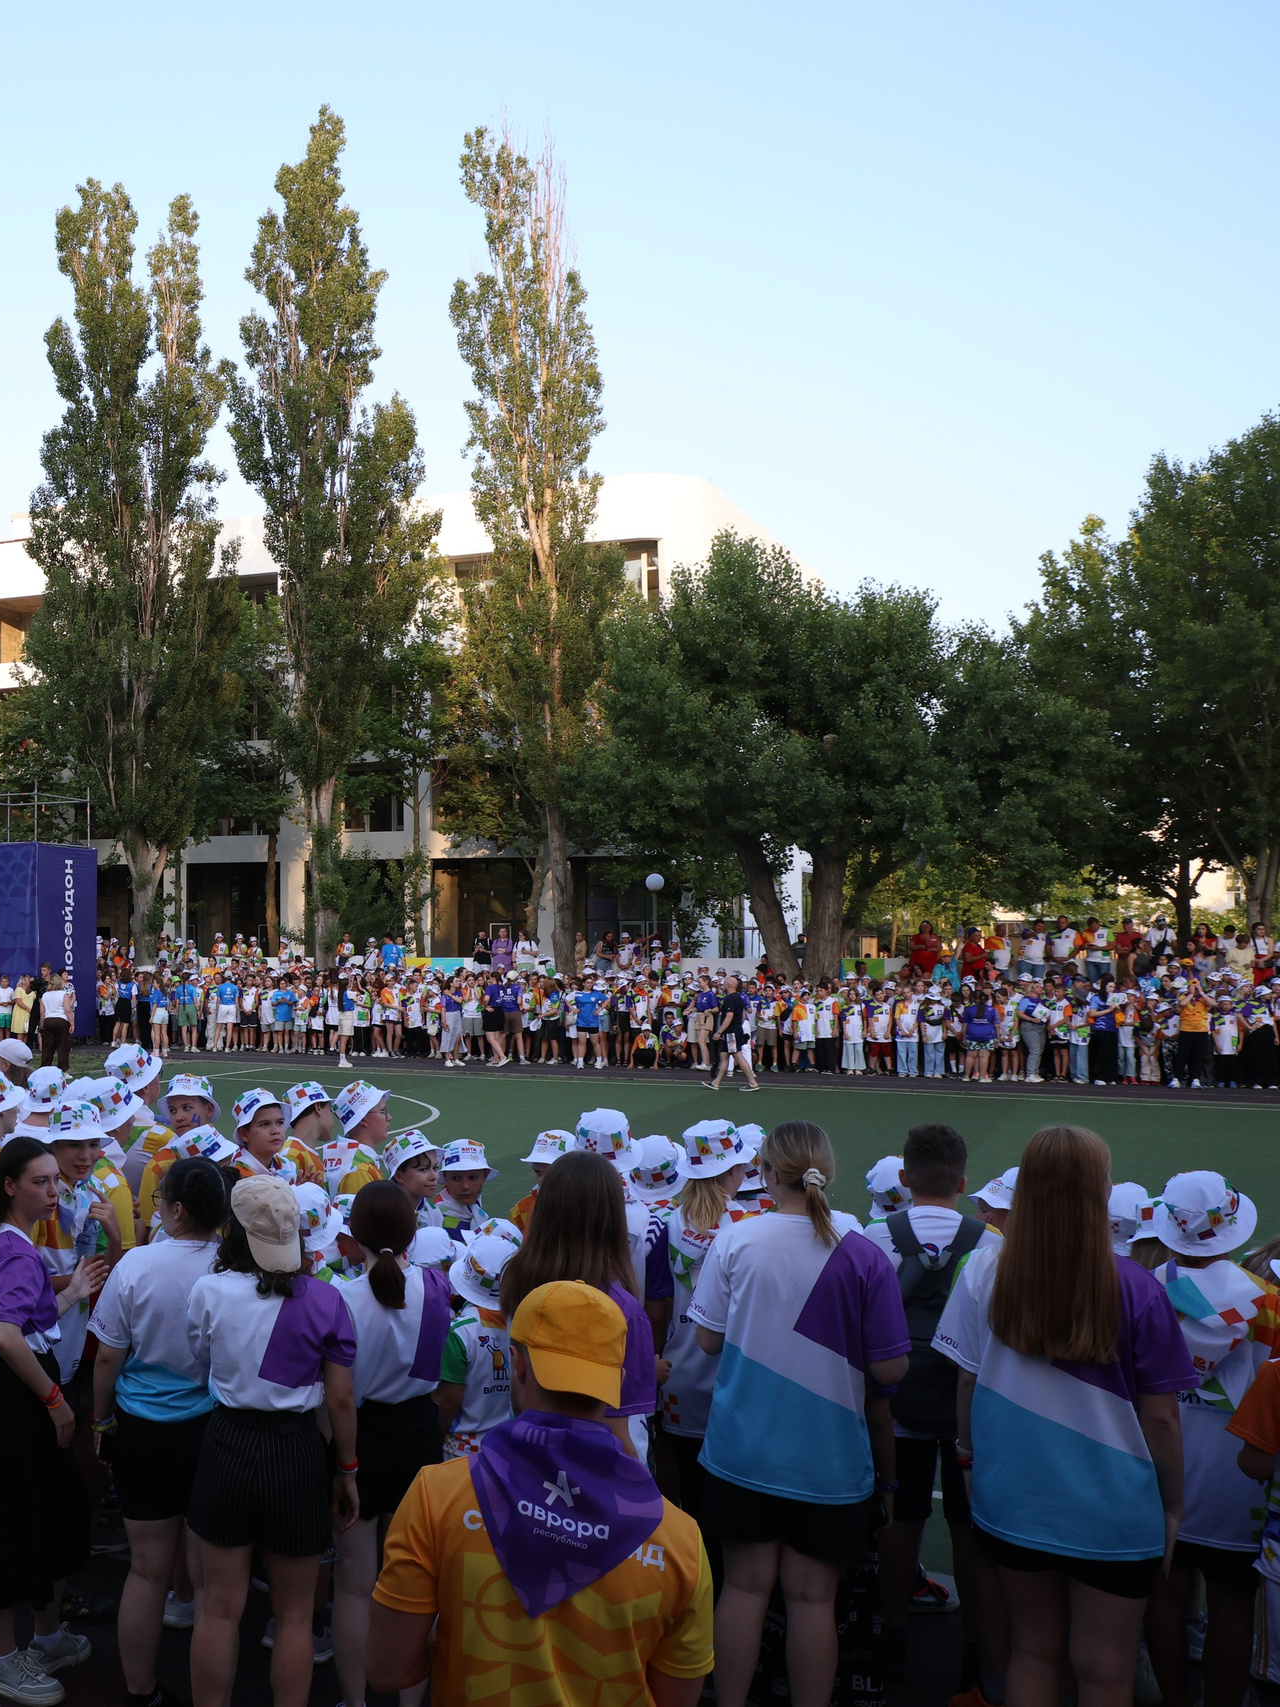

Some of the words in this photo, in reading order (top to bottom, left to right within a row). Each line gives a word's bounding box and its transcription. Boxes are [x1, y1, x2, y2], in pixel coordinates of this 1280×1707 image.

[191, 1113, 202, 1127] 4
[323, 1158, 342, 1168] ИТА
[682, 1228, 716, 1247] ВИТ
[694, 1303, 707, 1316] YOU
[940, 1333, 960, 1349] YOU
[483, 1384, 510, 1394] витал
[517, 1499, 610, 1541] аврора
[532, 1525, 589, 1550] республика
